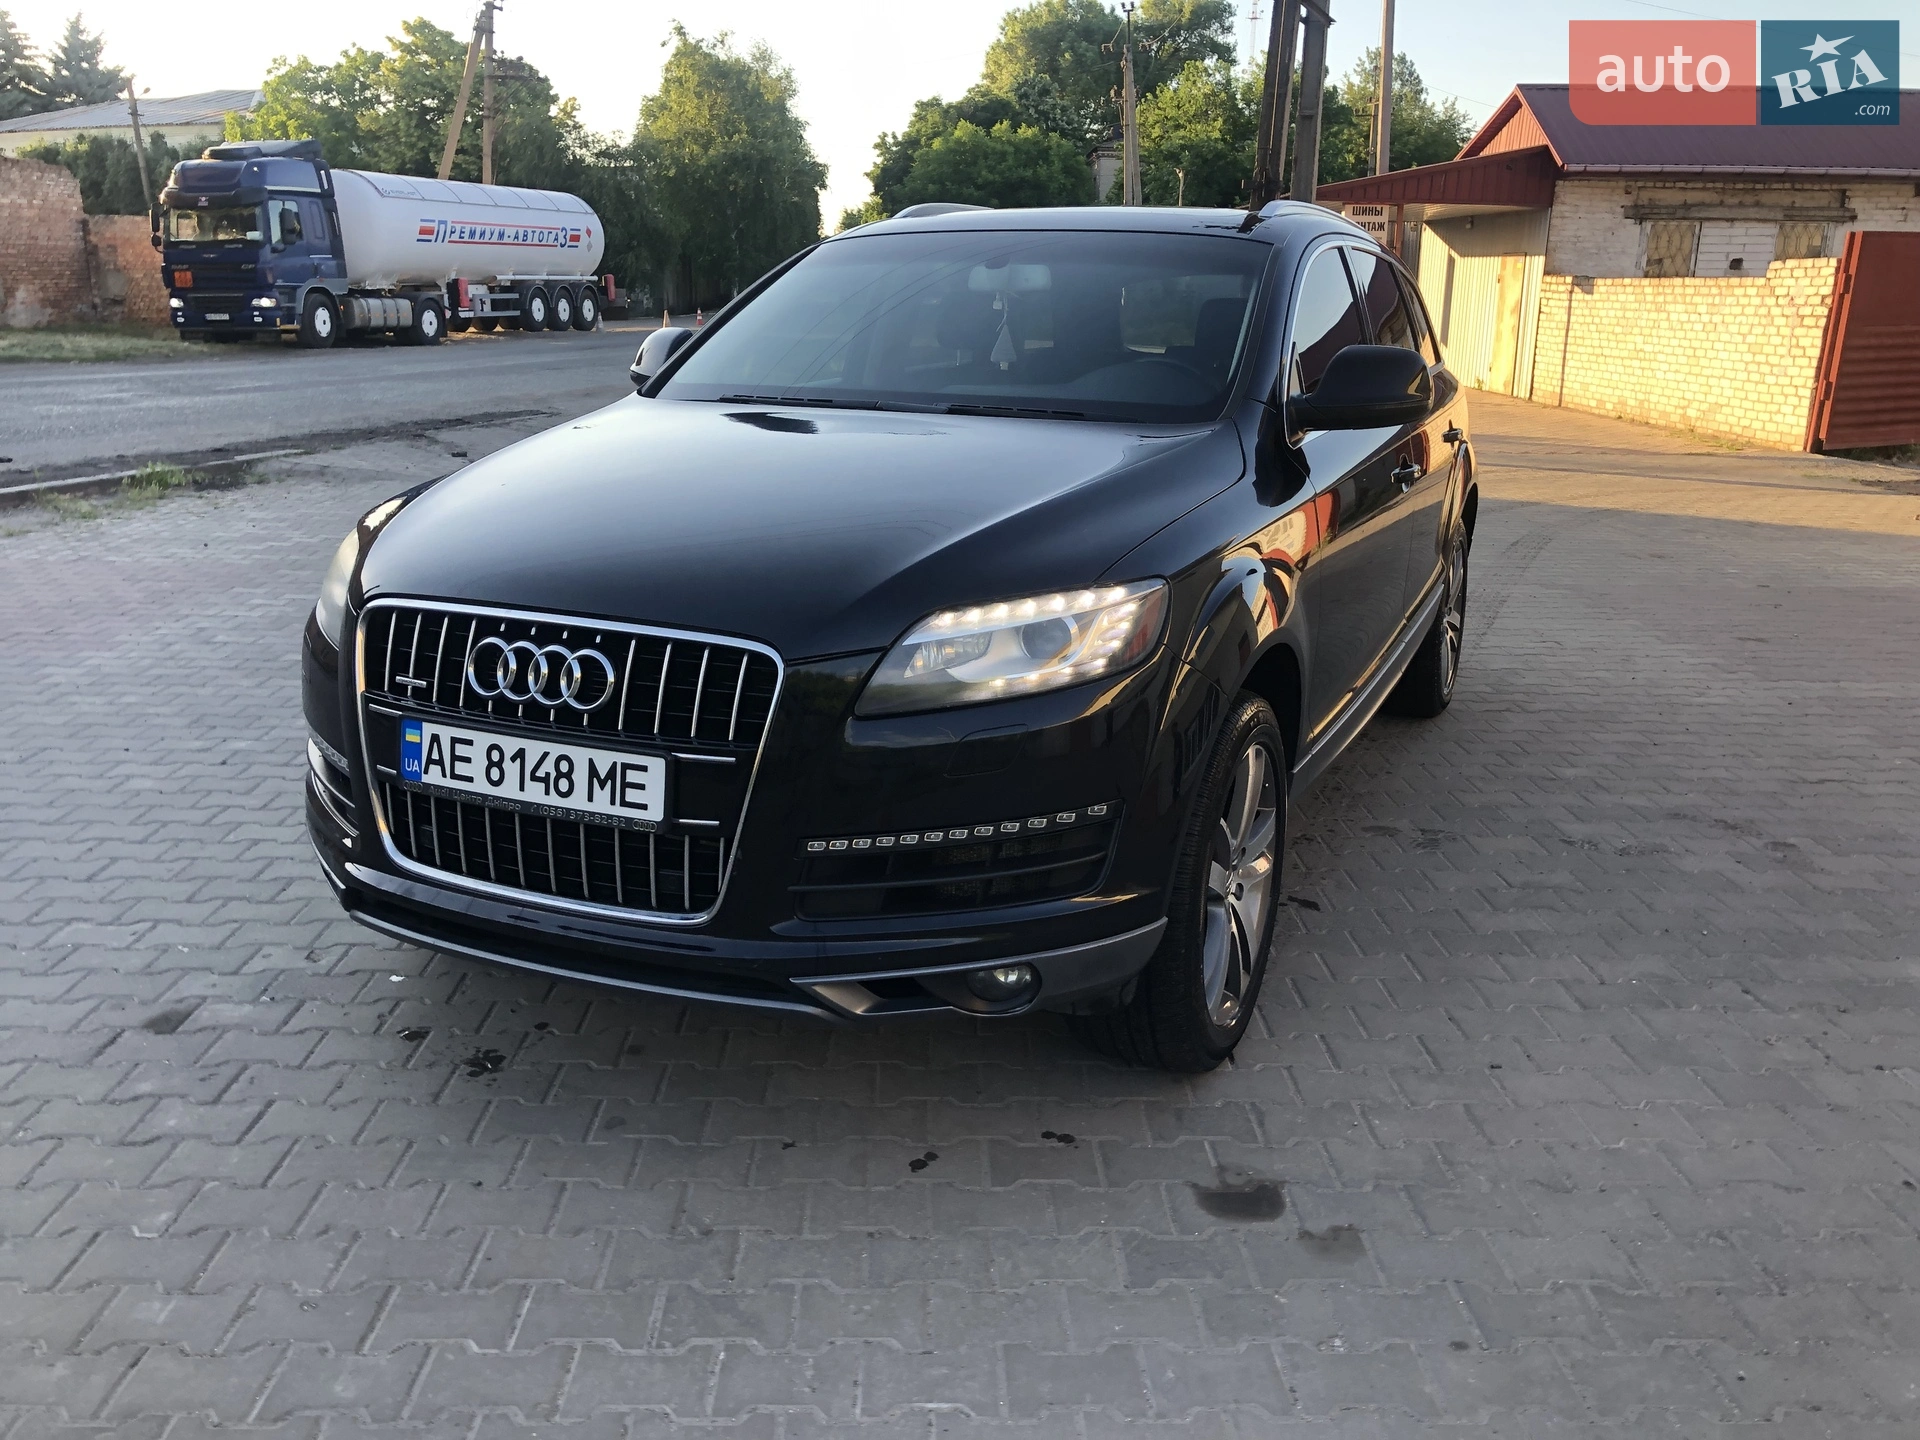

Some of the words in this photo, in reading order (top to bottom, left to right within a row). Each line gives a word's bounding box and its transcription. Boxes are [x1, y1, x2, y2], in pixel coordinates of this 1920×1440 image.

[1352, 205, 1384, 217] ШИНЫ
[434, 219, 568, 248] ПРЕМИУМ-АВТОГАЗ
[404, 757, 420, 774] UA
[422, 732, 475, 784] AE
[484, 742, 576, 799] 8148
[586, 756, 649, 812] ME
[429, 785, 449, 797] Audi
[485, 796, 522, 811] Дніпро
